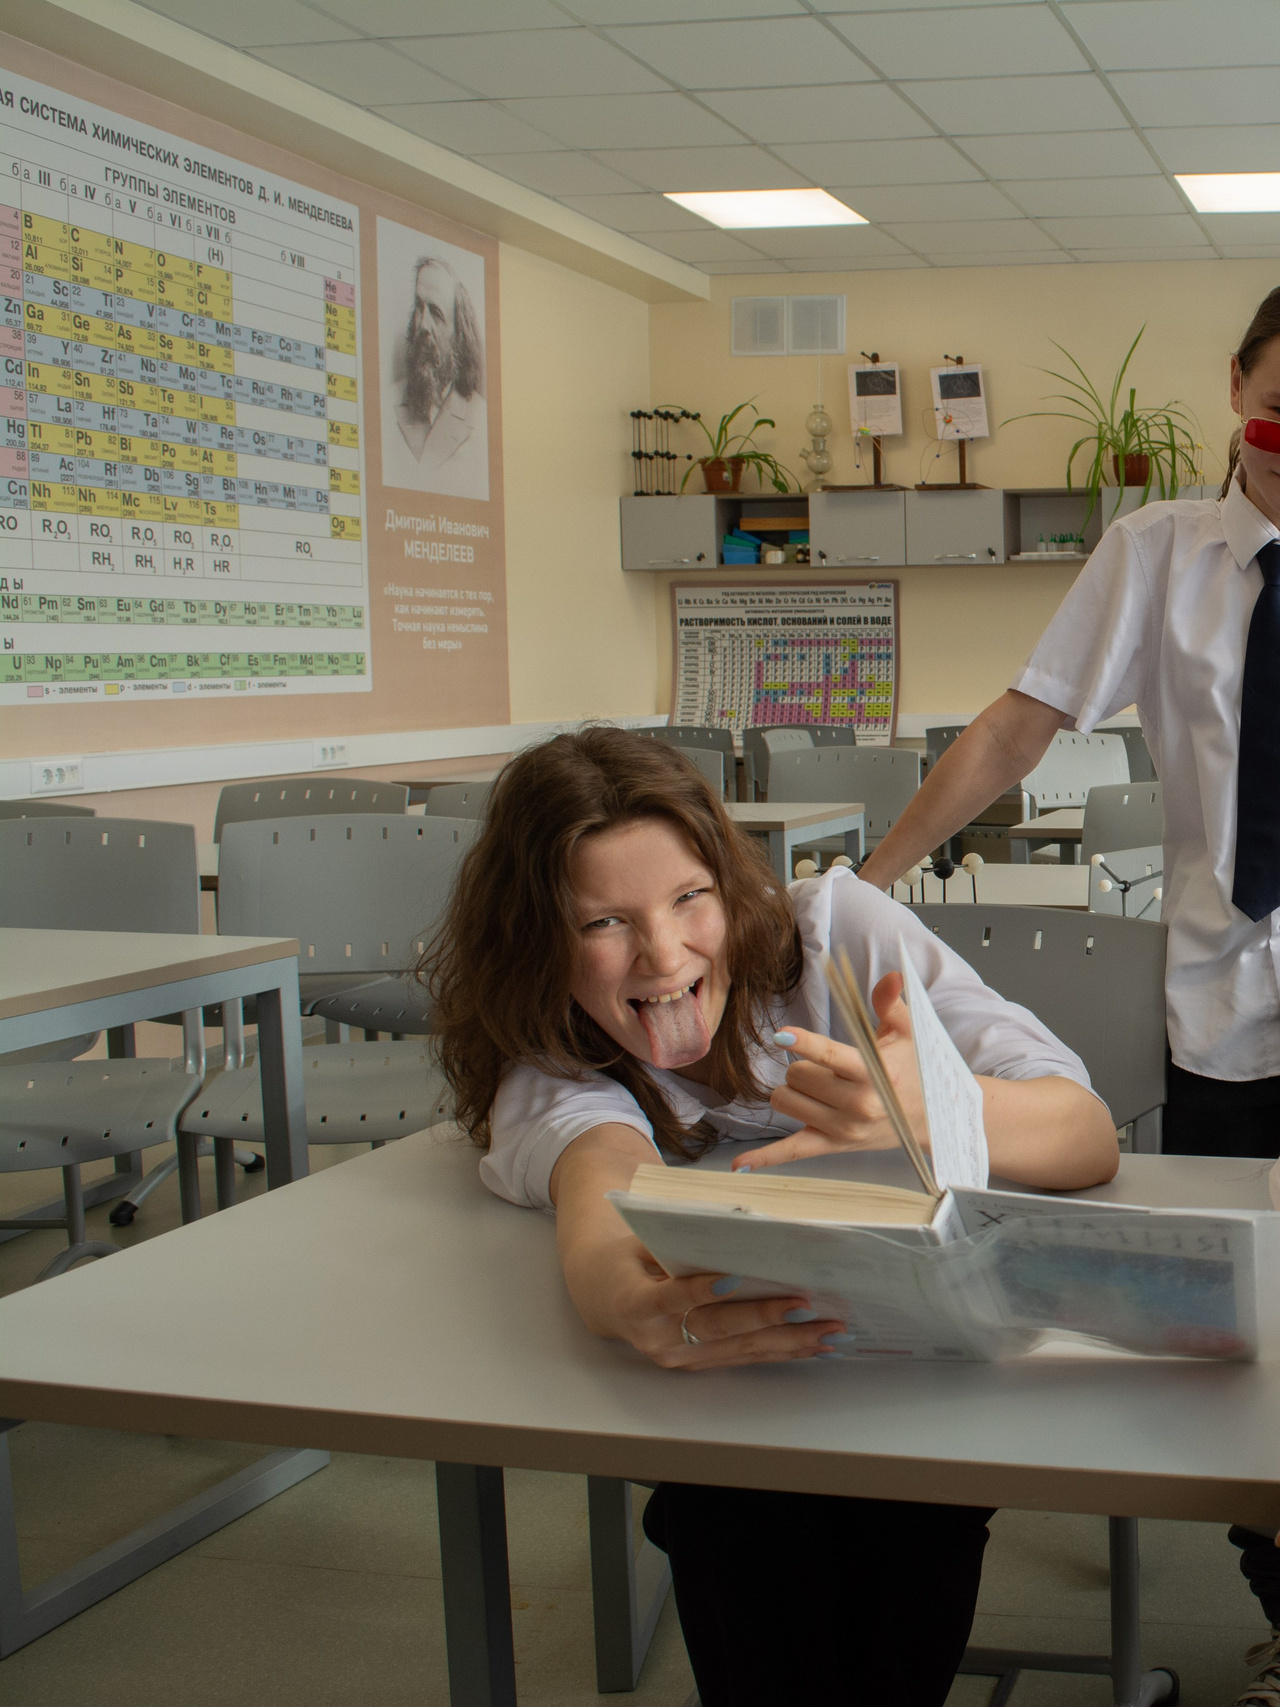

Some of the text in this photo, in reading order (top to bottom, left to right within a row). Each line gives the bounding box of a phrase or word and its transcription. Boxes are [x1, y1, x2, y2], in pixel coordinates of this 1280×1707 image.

[20, 96, 88, 135] СИСТЕМА
[92, 122, 179, 169] ХИМИЧЕСКИХ
[183, 157, 254, 195] ЭЛЕМЕНТОВ
[258, 185, 270, 202] Д.
[274, 190, 285, 207] И.
[288, 196, 354, 232] МЕНДЕЛЕЕВА
[38, 169, 51, 187] III
[84, 184, 96, 200] IV
[104, 166, 236, 224] ГРУППЫ ЭЛЕМЕНТОВ
[129, 199, 137, 214] V
[24, 214, 32, 228] B
[170, 212, 182, 229] VI
[71, 228, 79, 242] C
[206, 223, 220, 240] VII
[25, 234, 42, 244] 10,811
[25, 244, 38, 260] Al
[71, 246, 88, 256] 12,011
[115, 240, 123, 255] N
[157, 254, 165, 266] O
[207, 247, 224, 266] (H)
[289, 252, 305, 268] VIII
[72, 256, 83, 272] Si
[197, 265, 203, 277] F
[116, 269, 124, 281] P
[53, 280, 69, 296] Sc
[158, 280, 165, 293] S
[325, 280, 336, 293] He
[102, 292, 113, 308] Ti
[197, 291, 208, 305] Cl
[5, 298, 21, 315] Zn
[26, 304, 44, 320] Ga
[147, 304, 154, 317] V
[326, 303, 337, 316] Ne
[73, 315, 90, 330] Ge
[182, 313, 194, 327] Cr
[118, 325, 132, 340] As
[216, 322, 231, 337] Mn
[327, 327, 336, 339] Ar
[159, 335, 173, 349] Se
[251, 331, 263, 344] Fe
[61, 340, 69, 354] Y
[198, 344, 210, 358] Br
[279, 339, 292, 351] Co
[101, 349, 114, 364] Zr
[315, 347, 324, 359] Ni
[5, 359, 23, 375] Cd
[28, 363, 40, 378] In
[141, 358, 156, 373] Nb
[74, 372, 90, 387] Sn
[179, 366, 196, 381] Mo
[327, 374, 338, 386] Kr
[28, 383, 47, 392] 114,82
[119, 380, 134, 395] Sb
[220, 375, 232, 388] Tc
[252, 382, 264, 395] Ru
[161, 389, 174, 403] Te
[200, 397, 203, 408] I
[57, 397, 72, 413] La
[102, 406, 116, 420] Hf
[144, 413, 158, 428] Ta
[186, 420, 197, 434] W
[7, 419, 25, 438] Hg
[30, 424, 42, 438] Tl
[220, 426, 234, 440] Re
[329, 422, 340, 434] Xe
[76, 431, 92, 446] Pb
[120, 437, 131, 451] Bi
[253, 432, 266, 446] Os
[30, 442, 49, 452] 204,37
[162, 444, 176, 458] Po
[202, 450, 213, 463] At
[60, 458, 74, 472] Ac
[104, 463, 118, 477] Rf
[144, 468, 159, 482] Db
[185, 473, 199, 490] Sg
[330, 469, 341, 481] Rn
[8, 480, 27, 496] Cn
[32, 483, 51, 498] Nh
[223, 478, 235, 491] Bh
[78, 488, 96, 503] Nh
[122, 493, 140, 507] Mc
[164, 498, 178, 511] Lv
[204, 502, 216, 516] Ts
[332, 517, 345, 531] Og
[385, 509, 490, 538] Дмитрий Иванович
[404, 539, 475, 564] МЕНДЕЛЕЕВ
[383, 583, 413, 599] «Наука
[415, 587, 458, 599] начинается
[466, 590, 478, 600] тех
[479, 591, 494, 603] пор,
[1, 595, 19, 609] Nd
[39, 597, 58, 610] Pm
[395, 604, 485, 619] как начинают измерять.
[392, 618, 488, 635] Точная наука немыслима
[679, 615, 892, 627] РАСТВОРИМОСТЬ КИСЛОТ, ОСНОВАНИЙ И СОЛЕЙ В ВОДЕ
[423, 636, 463, 653] без меры»
[13, 656, 21, 669] U
[45, 656, 62, 671] Np
[59, 686, 98, 694] элементы
[133, 683, 168, 691] элементы
[199, 682, 231, 690] элементы
[257, 681, 287, 689] элементы
